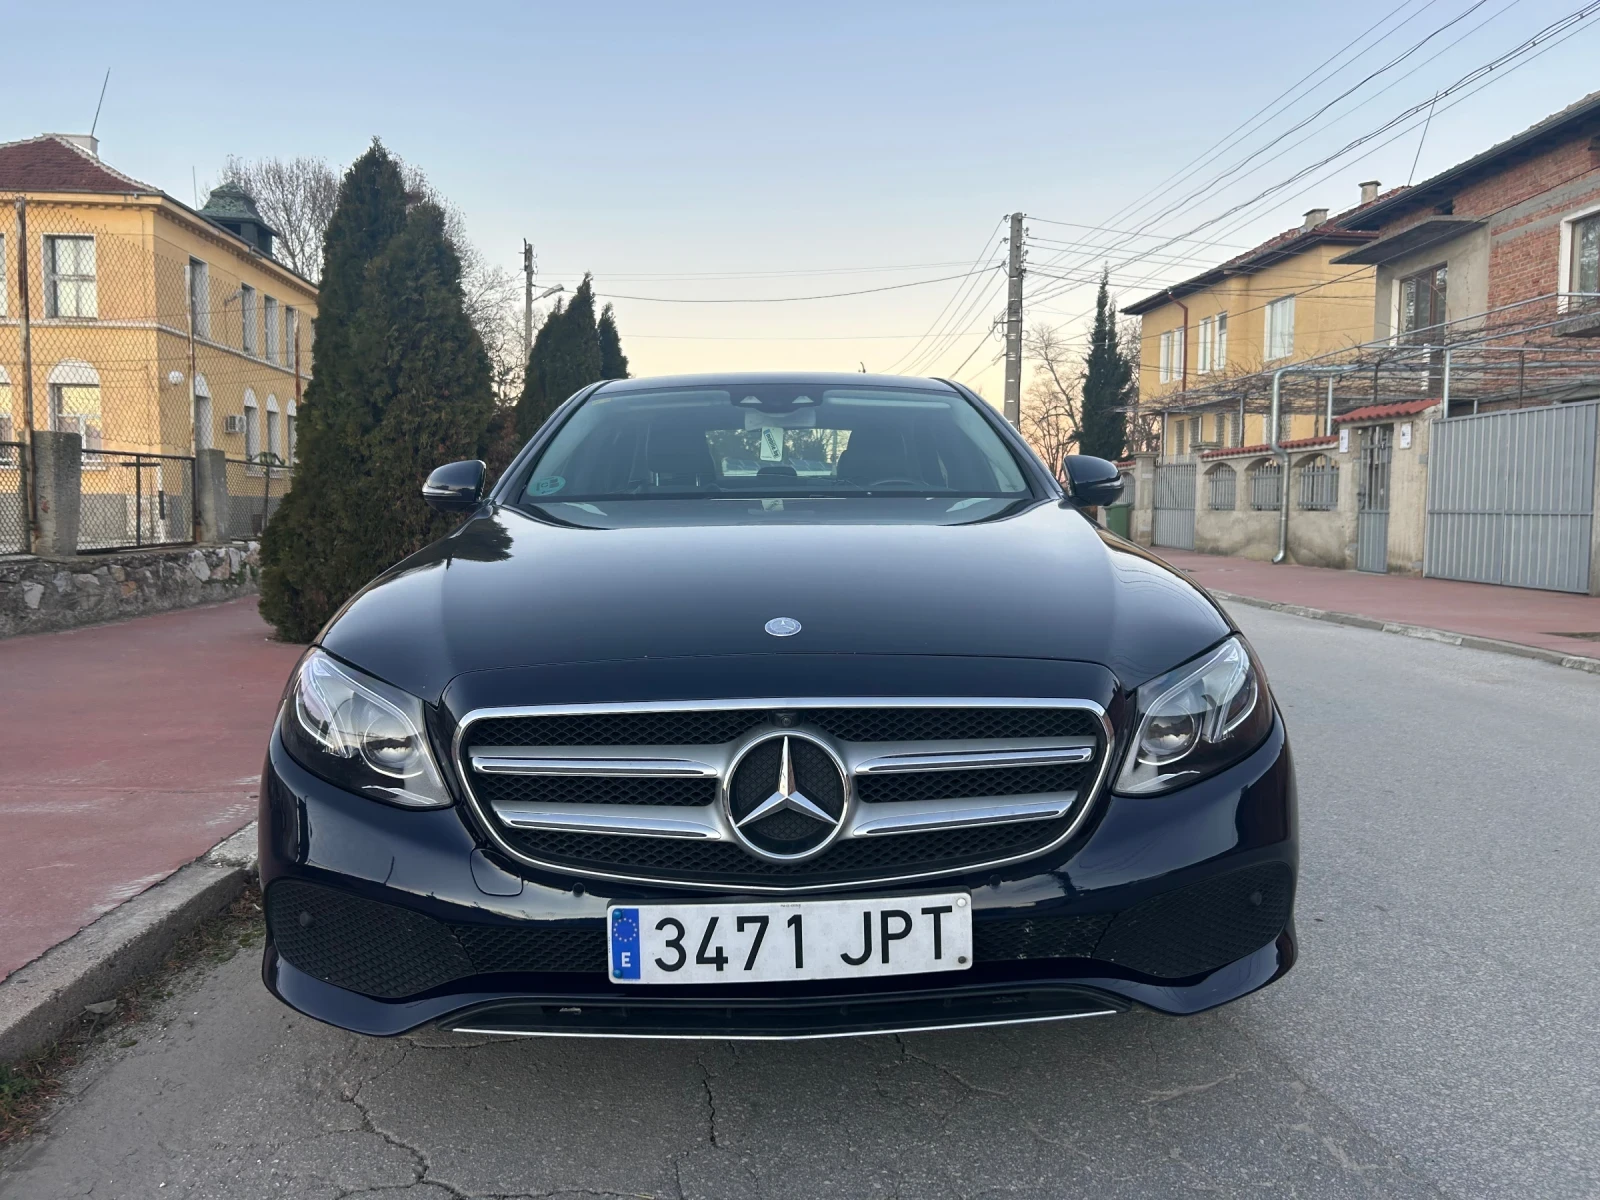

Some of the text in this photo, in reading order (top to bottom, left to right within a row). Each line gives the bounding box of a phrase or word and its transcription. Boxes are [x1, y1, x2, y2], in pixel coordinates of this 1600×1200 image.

[654, 905, 953, 972] 3471 JPT
[621, 952, 631, 967] E
